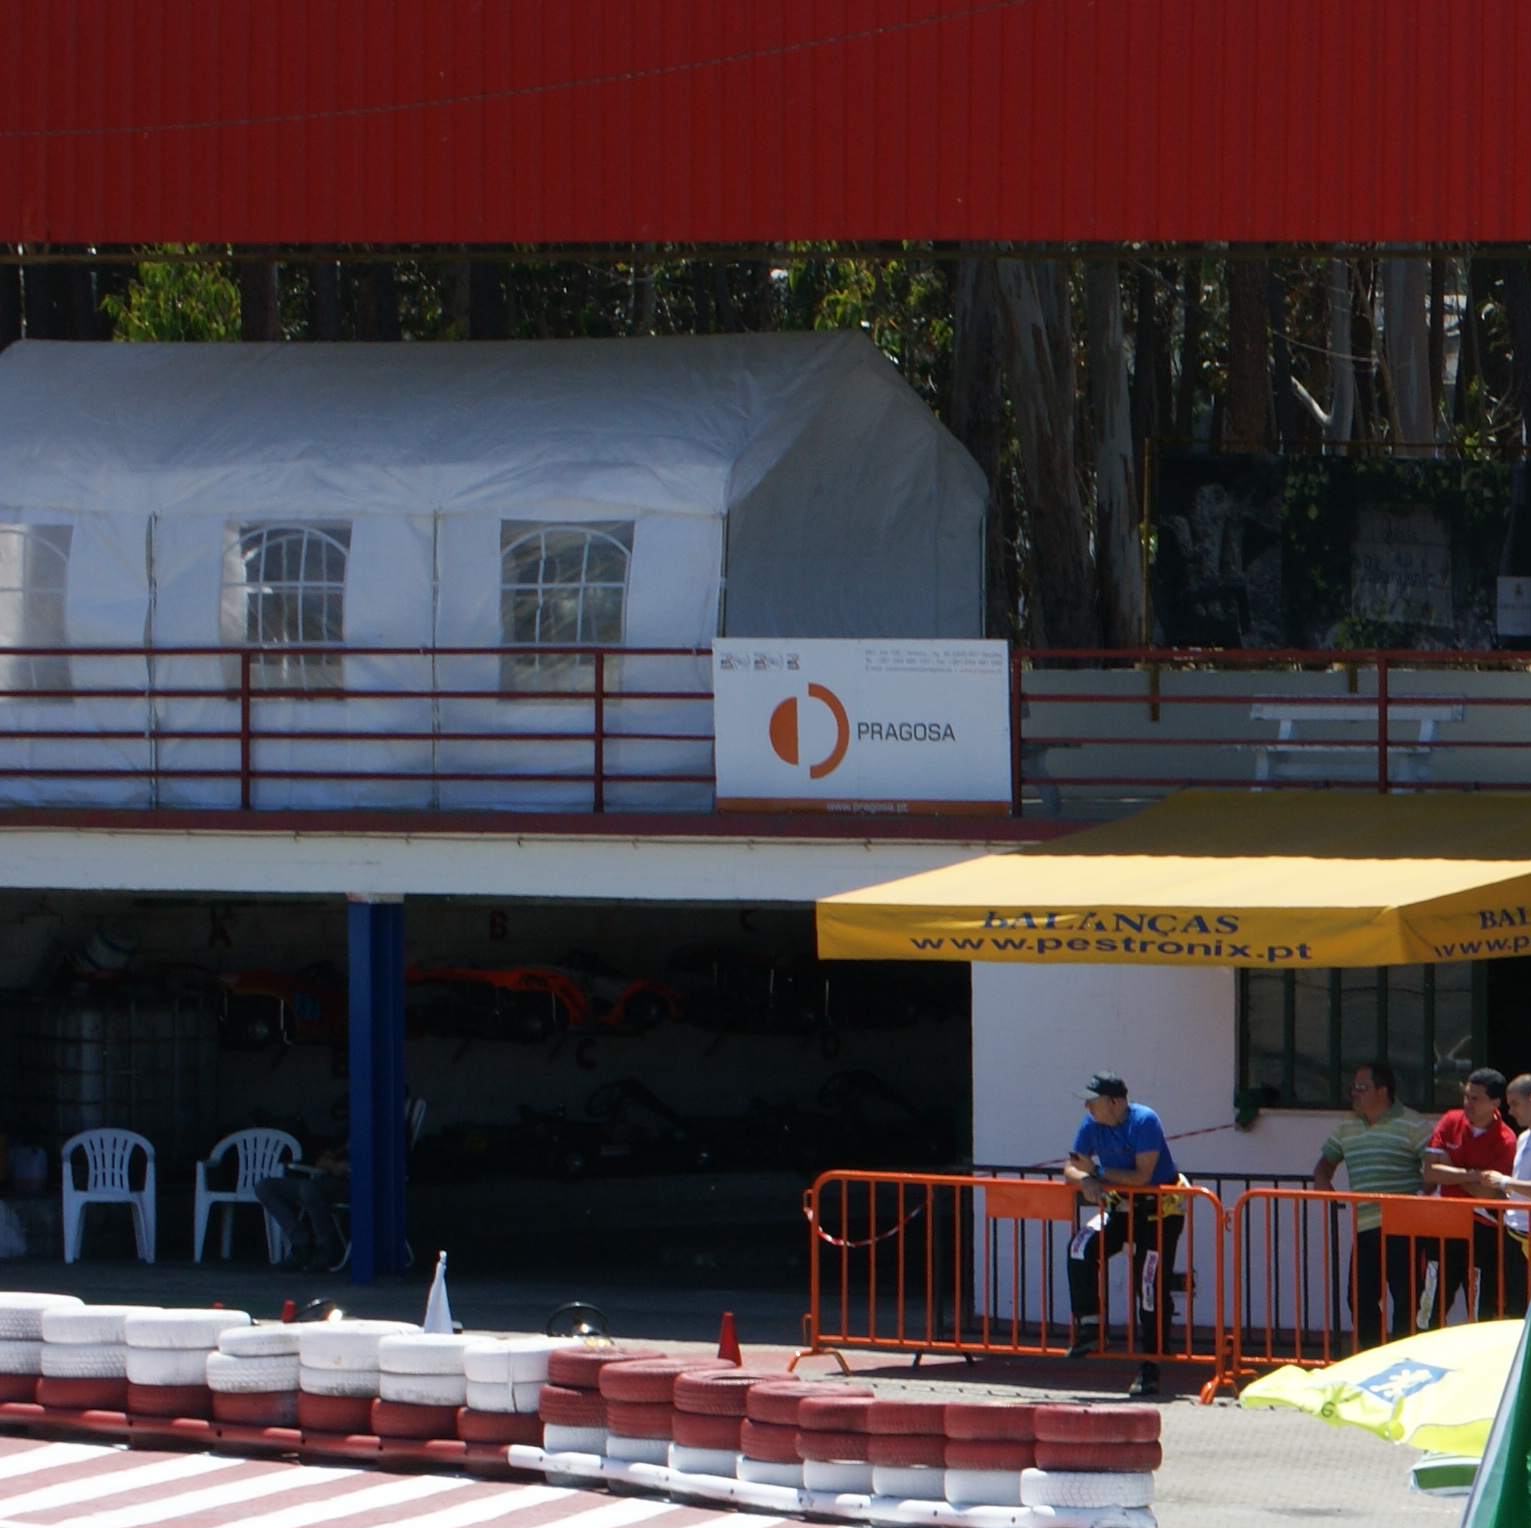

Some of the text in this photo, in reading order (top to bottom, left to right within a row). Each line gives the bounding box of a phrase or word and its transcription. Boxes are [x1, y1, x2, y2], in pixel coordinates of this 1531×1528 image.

[857, 722, 956, 742] PRAGOSA
[488, 909, 508, 940] B
[979, 910, 1240, 937] BALANÇAS
[909, 935, 1314, 962] www.pestronix.pt
